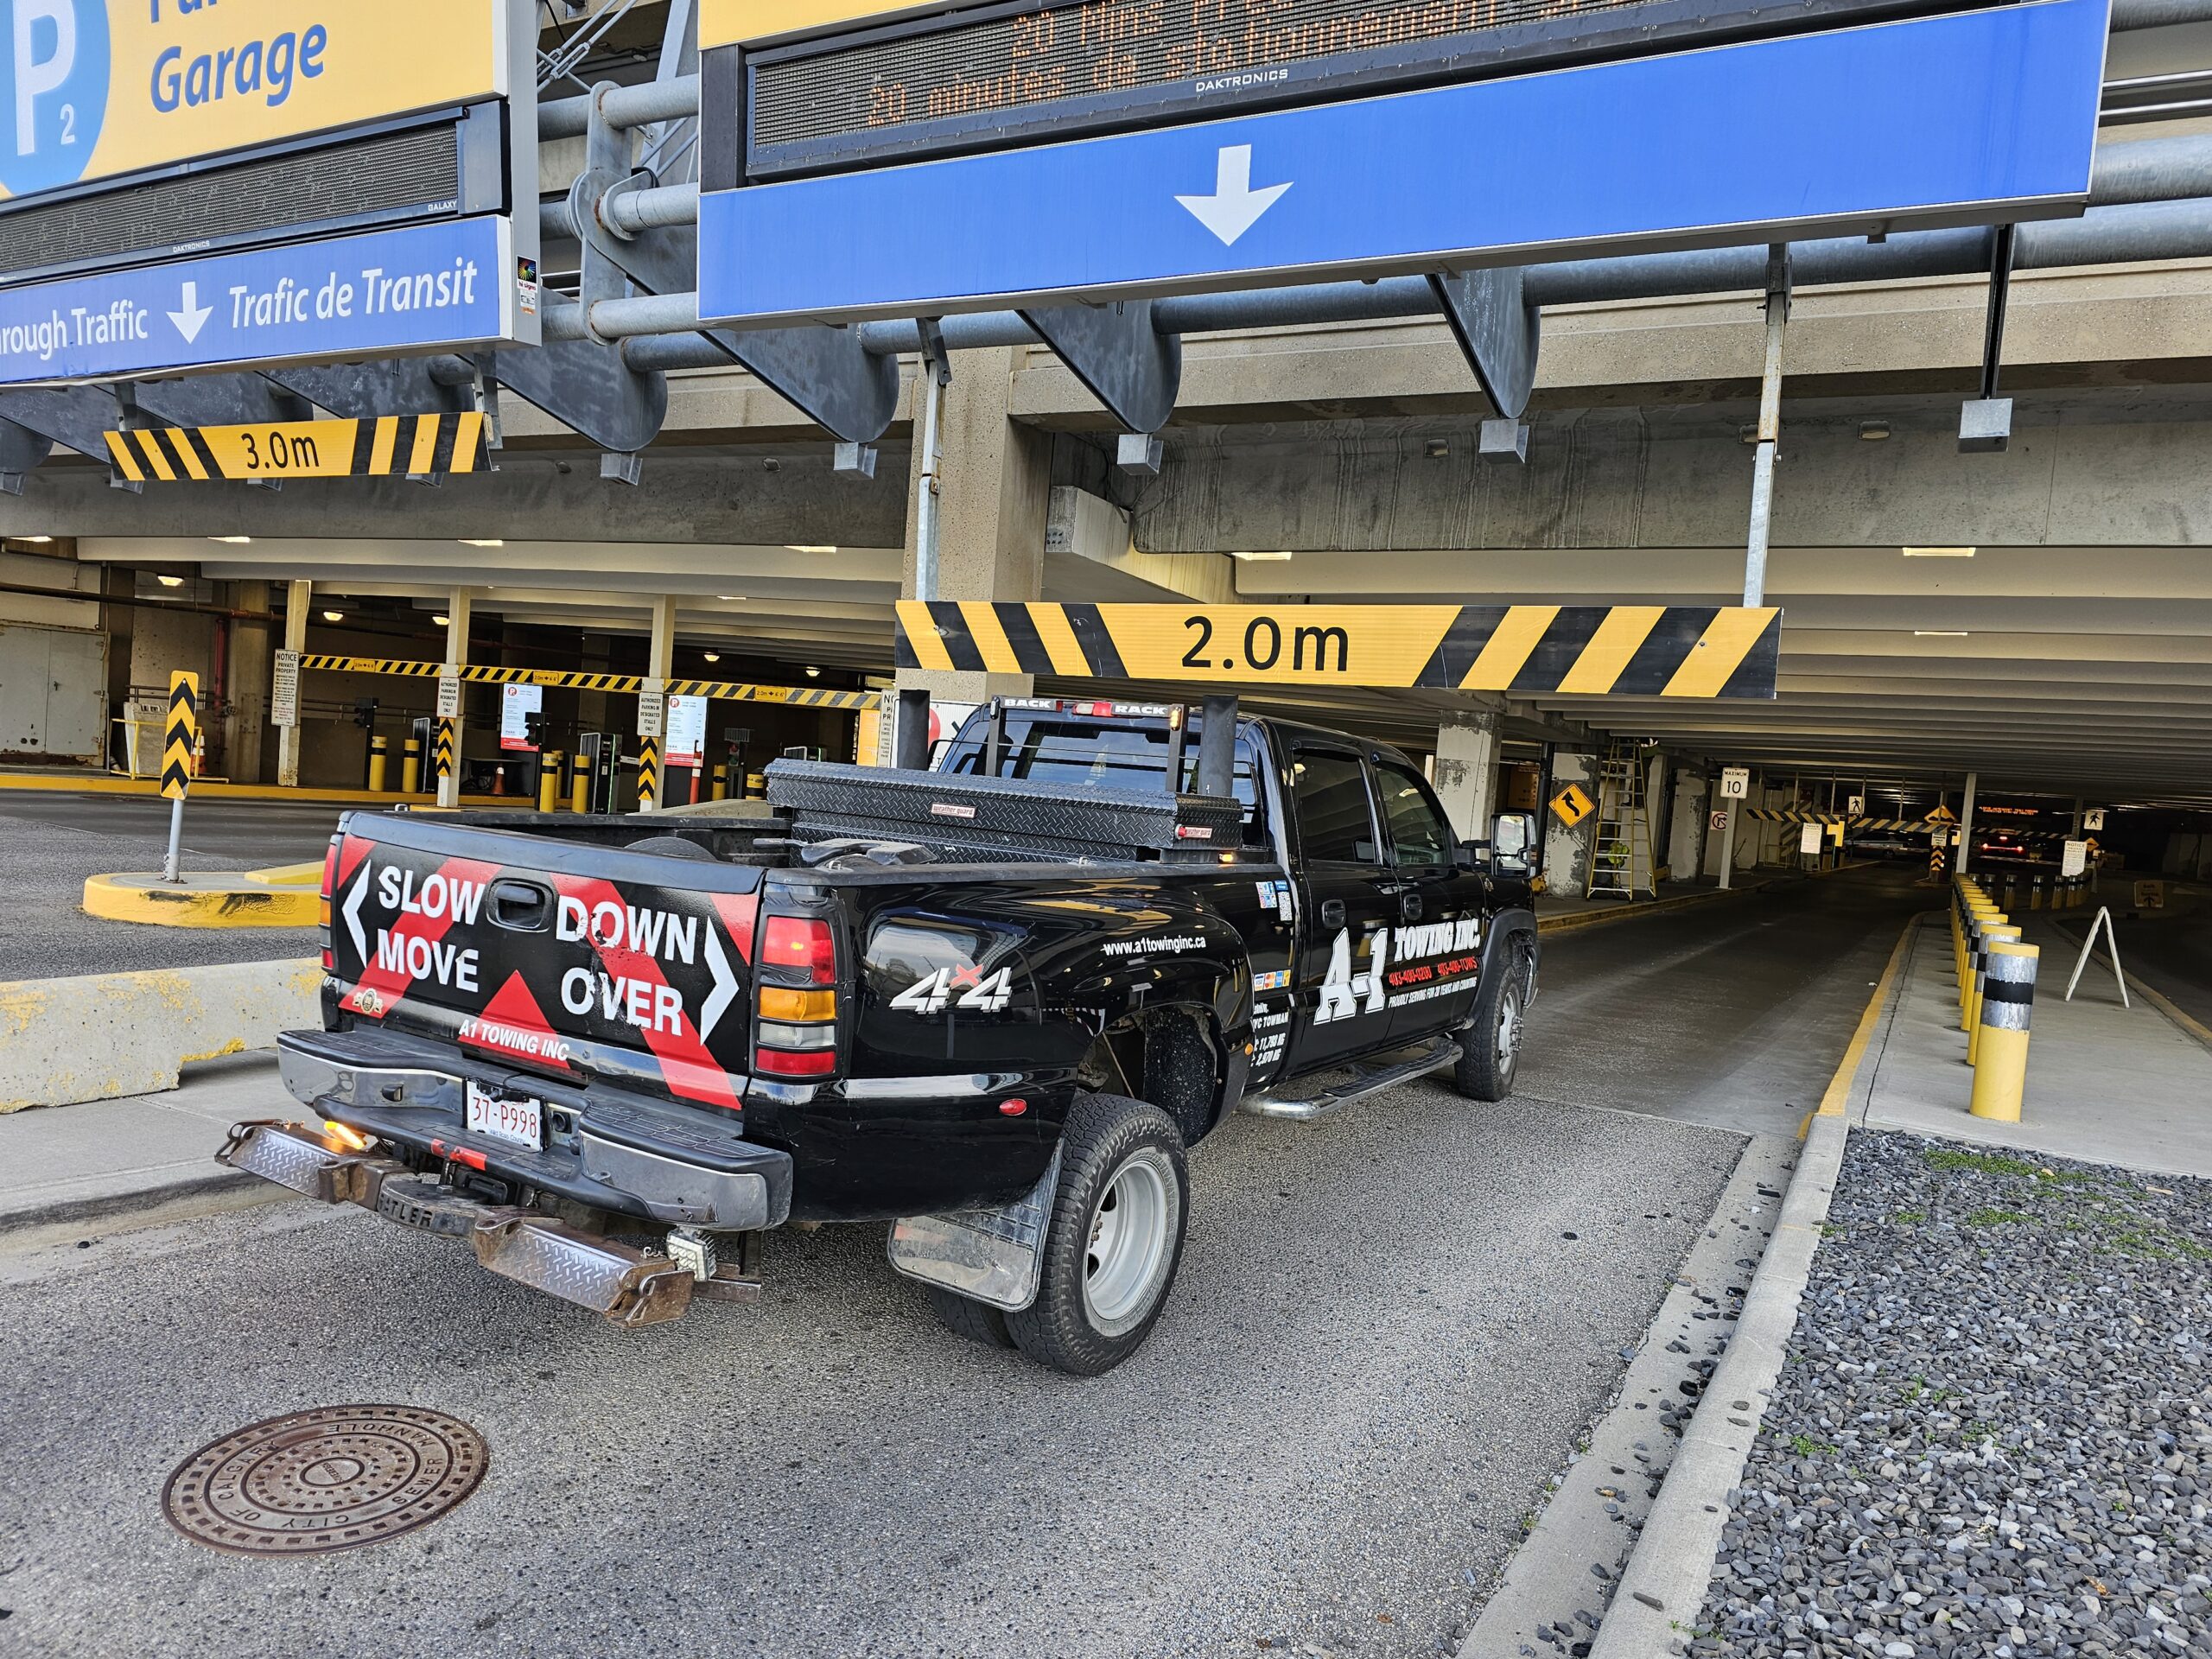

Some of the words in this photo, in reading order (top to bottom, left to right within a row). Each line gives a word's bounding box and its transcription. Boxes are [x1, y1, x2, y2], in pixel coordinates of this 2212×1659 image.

[1012, 12, 1055, 57] 20
[13, 0, 76, 156] P
[60, 103, 75, 145] 2
[150, 23, 327, 113] Garage
[868, 83, 906, 126] 20
[929, 61, 1065, 116] minutes
[1092, 45, 1137, 90] de
[1196, 68, 1288, 92] DAKTRONICS
[428, 200, 458, 213] GALAXY
[173, 240, 210, 253] DAKTRONICS
[229, 277, 309, 328] Trafic
[315, 271, 353, 321] de
[361, 257, 478, 315] Transit
[0, 308, 67, 361] rough
[71, 299, 149, 346] Traffic
[241, 431, 320, 470] 3.0m
[1181, 615, 1351, 672] 2.0m
[1004, 698, 1051, 709] BACK
[1115, 705, 1168, 715] RACK
[1727, 780, 1741, 794] 10
[378, 865, 486, 925] SLOW
[556, 894, 697, 965] DOWN
[1103, 935, 1206, 957] www.a1towinginc.ca
[1394, 922, 1454, 962] TOWING
[1452, 918, 1481, 951] INC.
[377, 928, 479, 993] MOVE
[561, 966, 683, 1037] OVER
[1313, 927, 1389, 1026] A-1
[1388, 994, 1409, 1009] PROUDLY
[1408, 988, 1427, 1004] SERVING
[459, 1019, 476, 1038] A1
[480, 1023, 538, 1054] TOWING
[540, 1039, 570, 1062] INC
[1263, 1012, 1288, 1028] TOWMAN
[473, 1096, 537, 1138] 37-P998
[327, 1423, 436, 1447] MANHOLE
[217, 1440, 275, 1500] CALGARY
[392, 1458, 443, 1503] SEWER
[229, 1509, 261, 1521] OF
[281, 1514, 349, 1529] CITY
